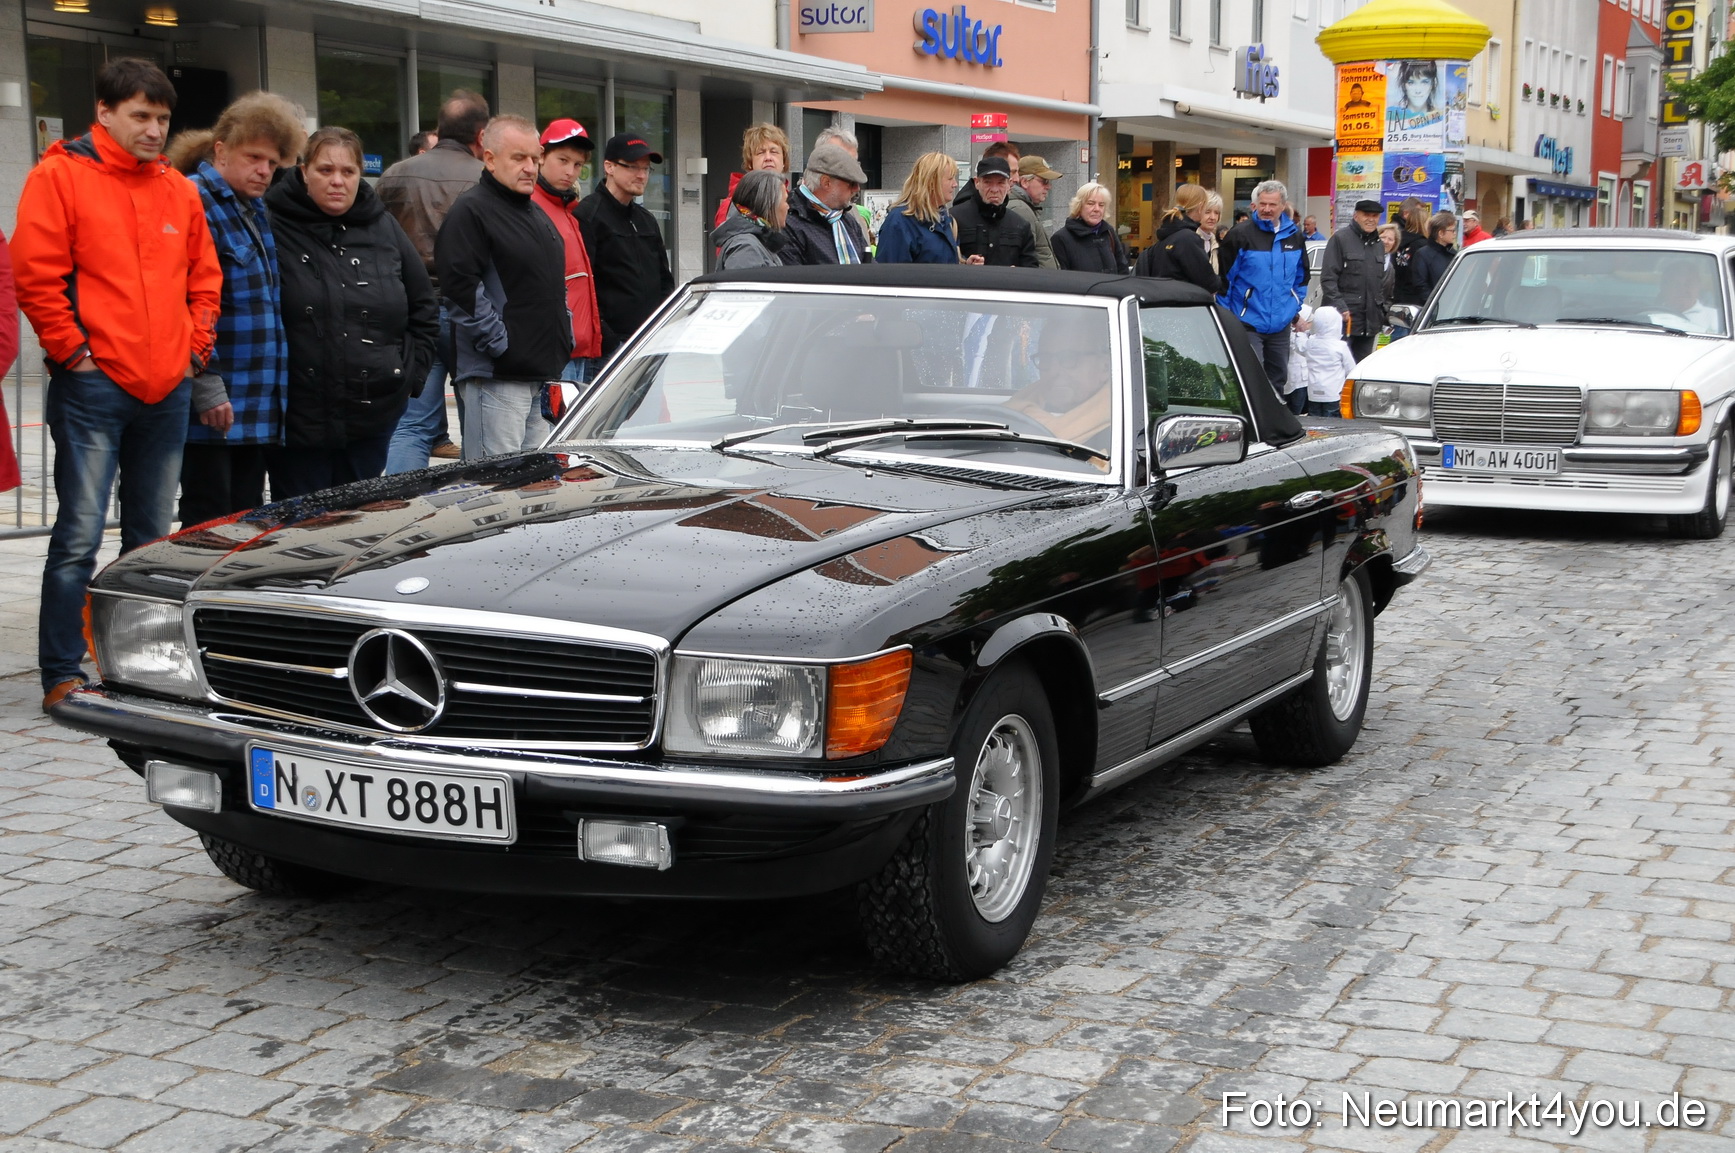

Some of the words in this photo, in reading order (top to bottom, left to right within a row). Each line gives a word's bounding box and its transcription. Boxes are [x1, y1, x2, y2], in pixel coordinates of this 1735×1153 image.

[801, 3, 866, 25] sutor.
[917, 5, 1003, 67] sutor.
[1342, 111, 1376, 121] Samstag
[1342, 122, 1374, 131] 01.06.
[1387, 133, 1411, 142] 25.6.
[1223, 157, 1258, 167] FRIES
[703, 309, 739, 321] 431
[1454, 449, 1475, 466] NM
[1513, 452, 1557, 470] 400H
[274, 759, 298, 806] N
[325, 768, 374, 818] XT
[386, 776, 503, 830] 888H
